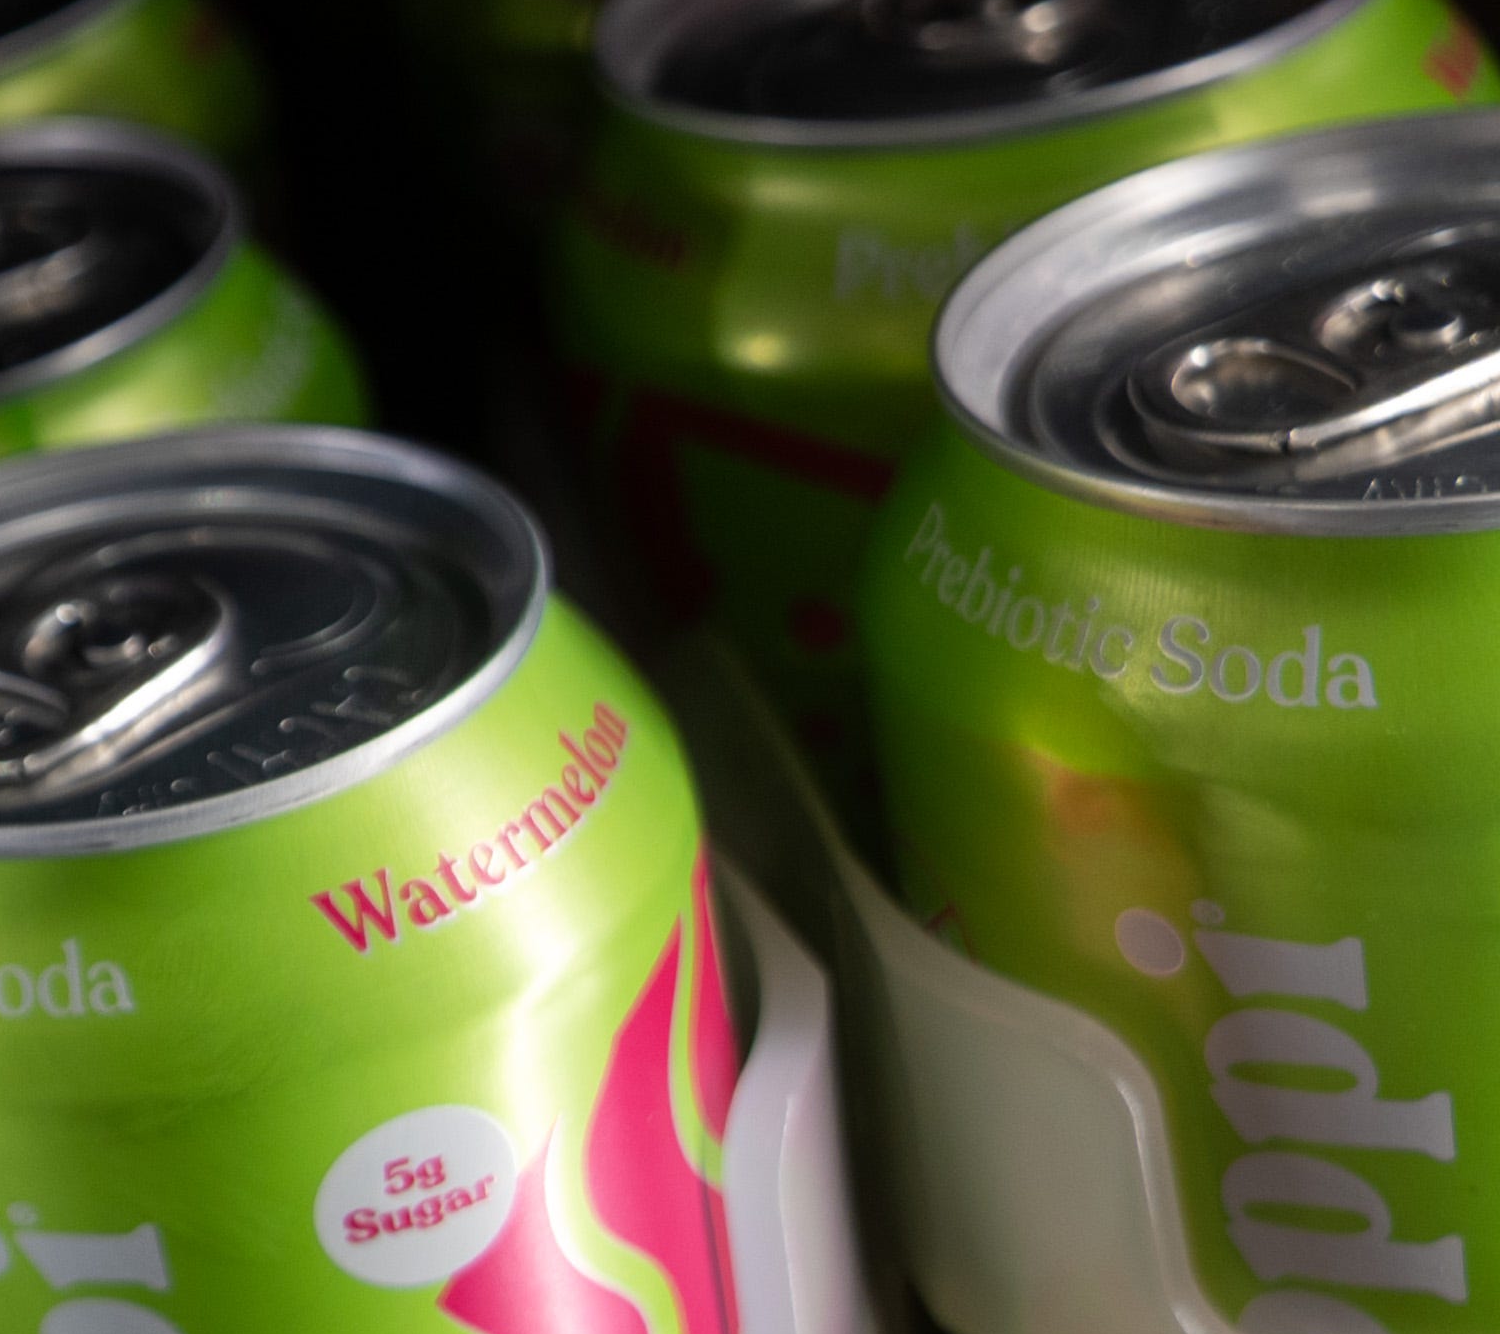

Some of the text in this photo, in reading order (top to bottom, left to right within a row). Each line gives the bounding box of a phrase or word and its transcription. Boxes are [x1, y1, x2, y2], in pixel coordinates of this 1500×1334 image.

[902, 499, 1383, 713] Prebiotic Soda
[306, 698, 634, 957] Watermelon
[341, 1169, 499, 1249] Sugar
[378, 1147, 453, 1201] 5g
